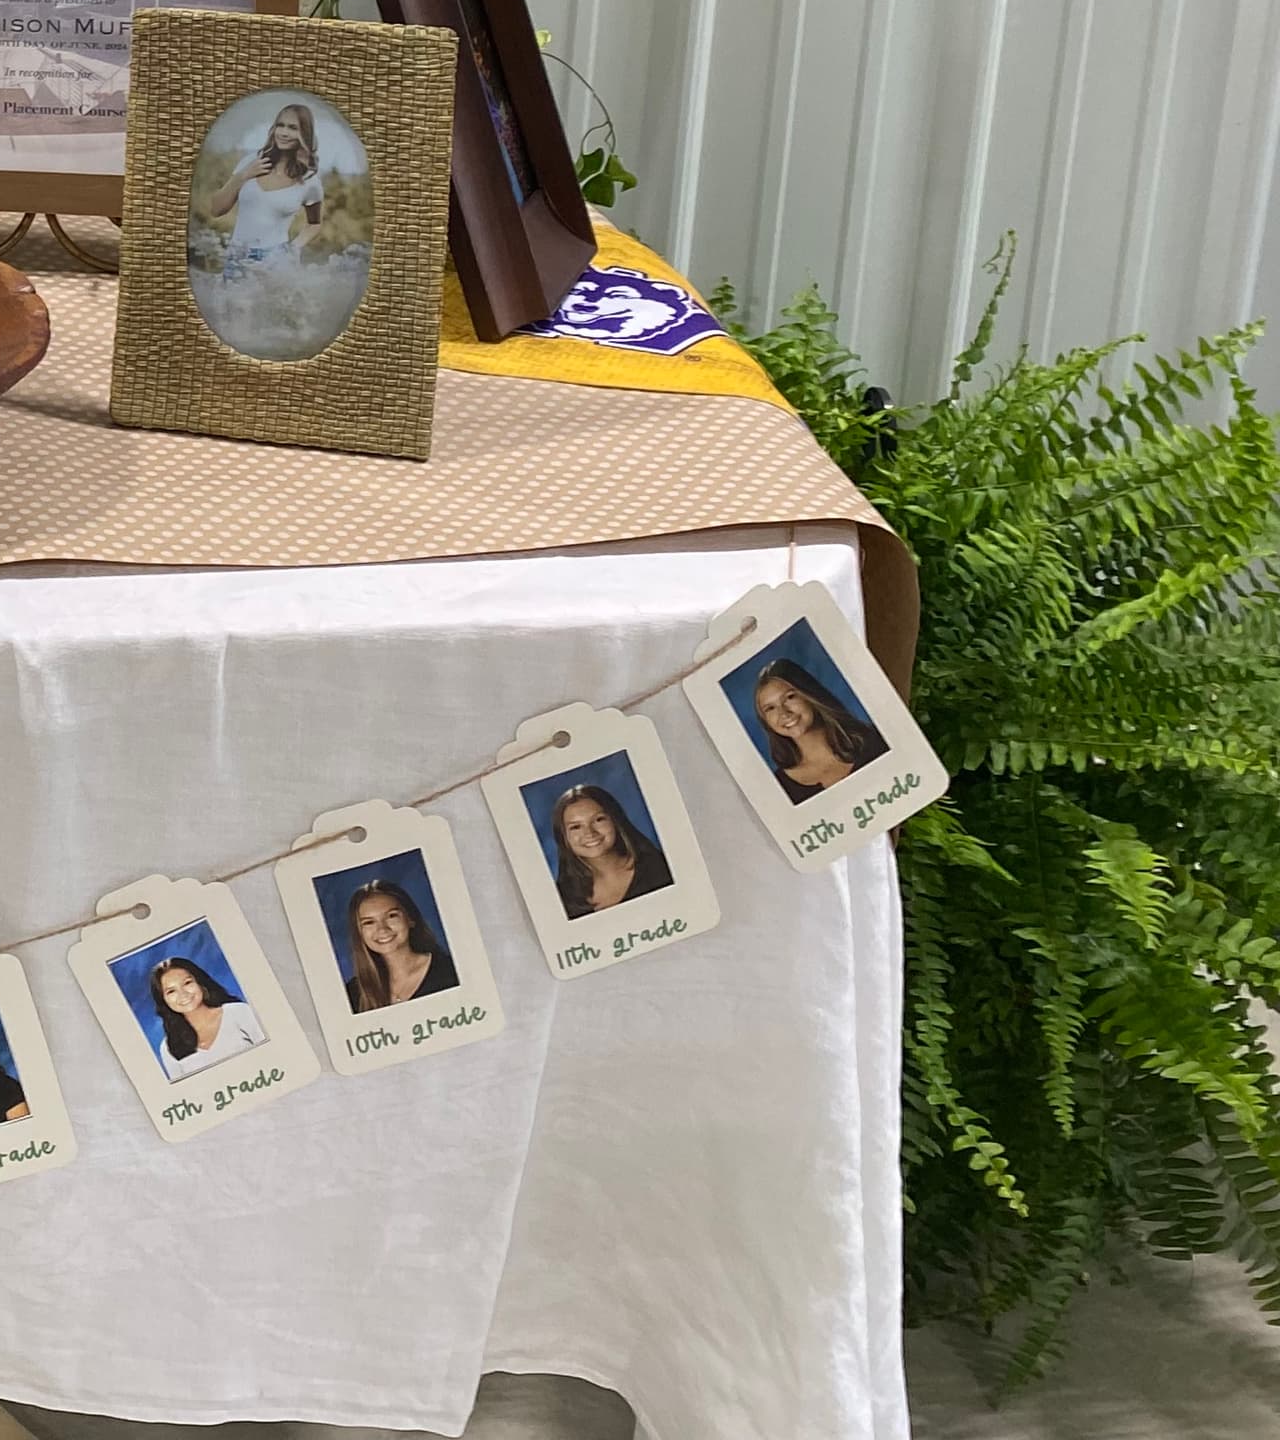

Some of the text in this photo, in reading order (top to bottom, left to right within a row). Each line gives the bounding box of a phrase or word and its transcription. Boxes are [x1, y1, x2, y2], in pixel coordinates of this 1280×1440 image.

[23, 40, 46, 48] DAY
[75, 18, 132, 35] MUF
[4, 67, 93, 81] In recognition for
[3, 101, 73, 116] Placement
[789, 767, 922, 860] 12th grade
[556, 915, 688, 971] 11th grade
[344, 1001, 487, 1058] 10th grade
[161, 1065, 286, 1127] 9th grade
